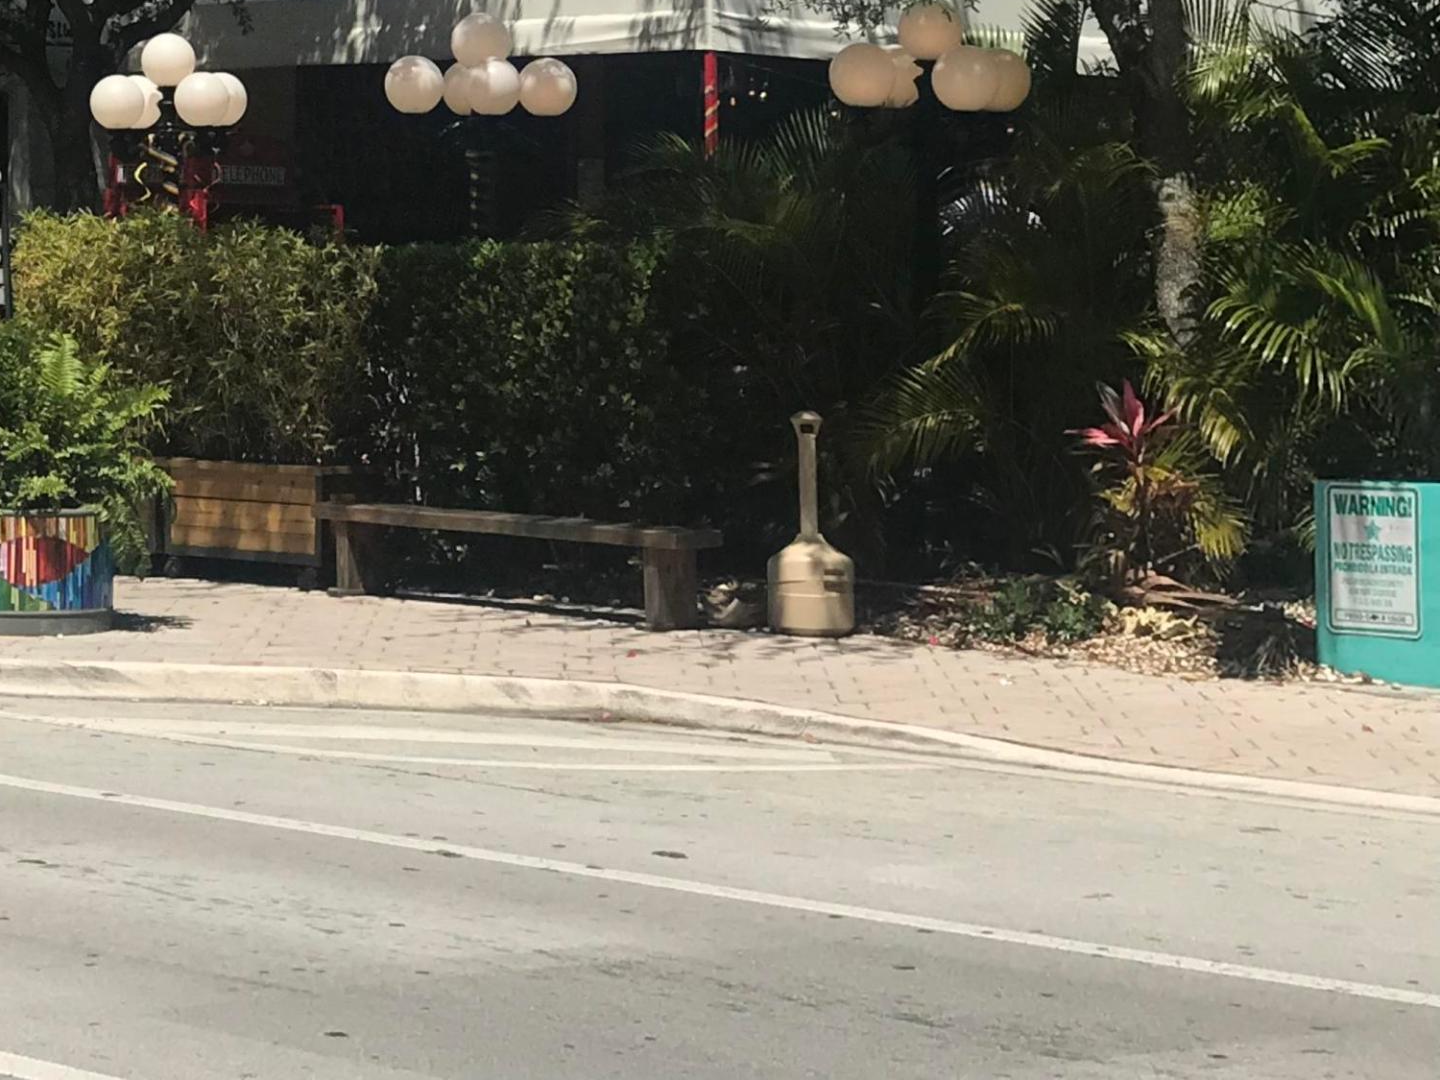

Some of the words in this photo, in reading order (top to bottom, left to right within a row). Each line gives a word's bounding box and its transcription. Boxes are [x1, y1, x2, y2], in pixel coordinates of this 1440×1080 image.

[1333, 493, 1413, 518] WARNING!
[1333, 542, 1347, 560] NO
[1348, 542, 1413, 564] TRESPASSING
